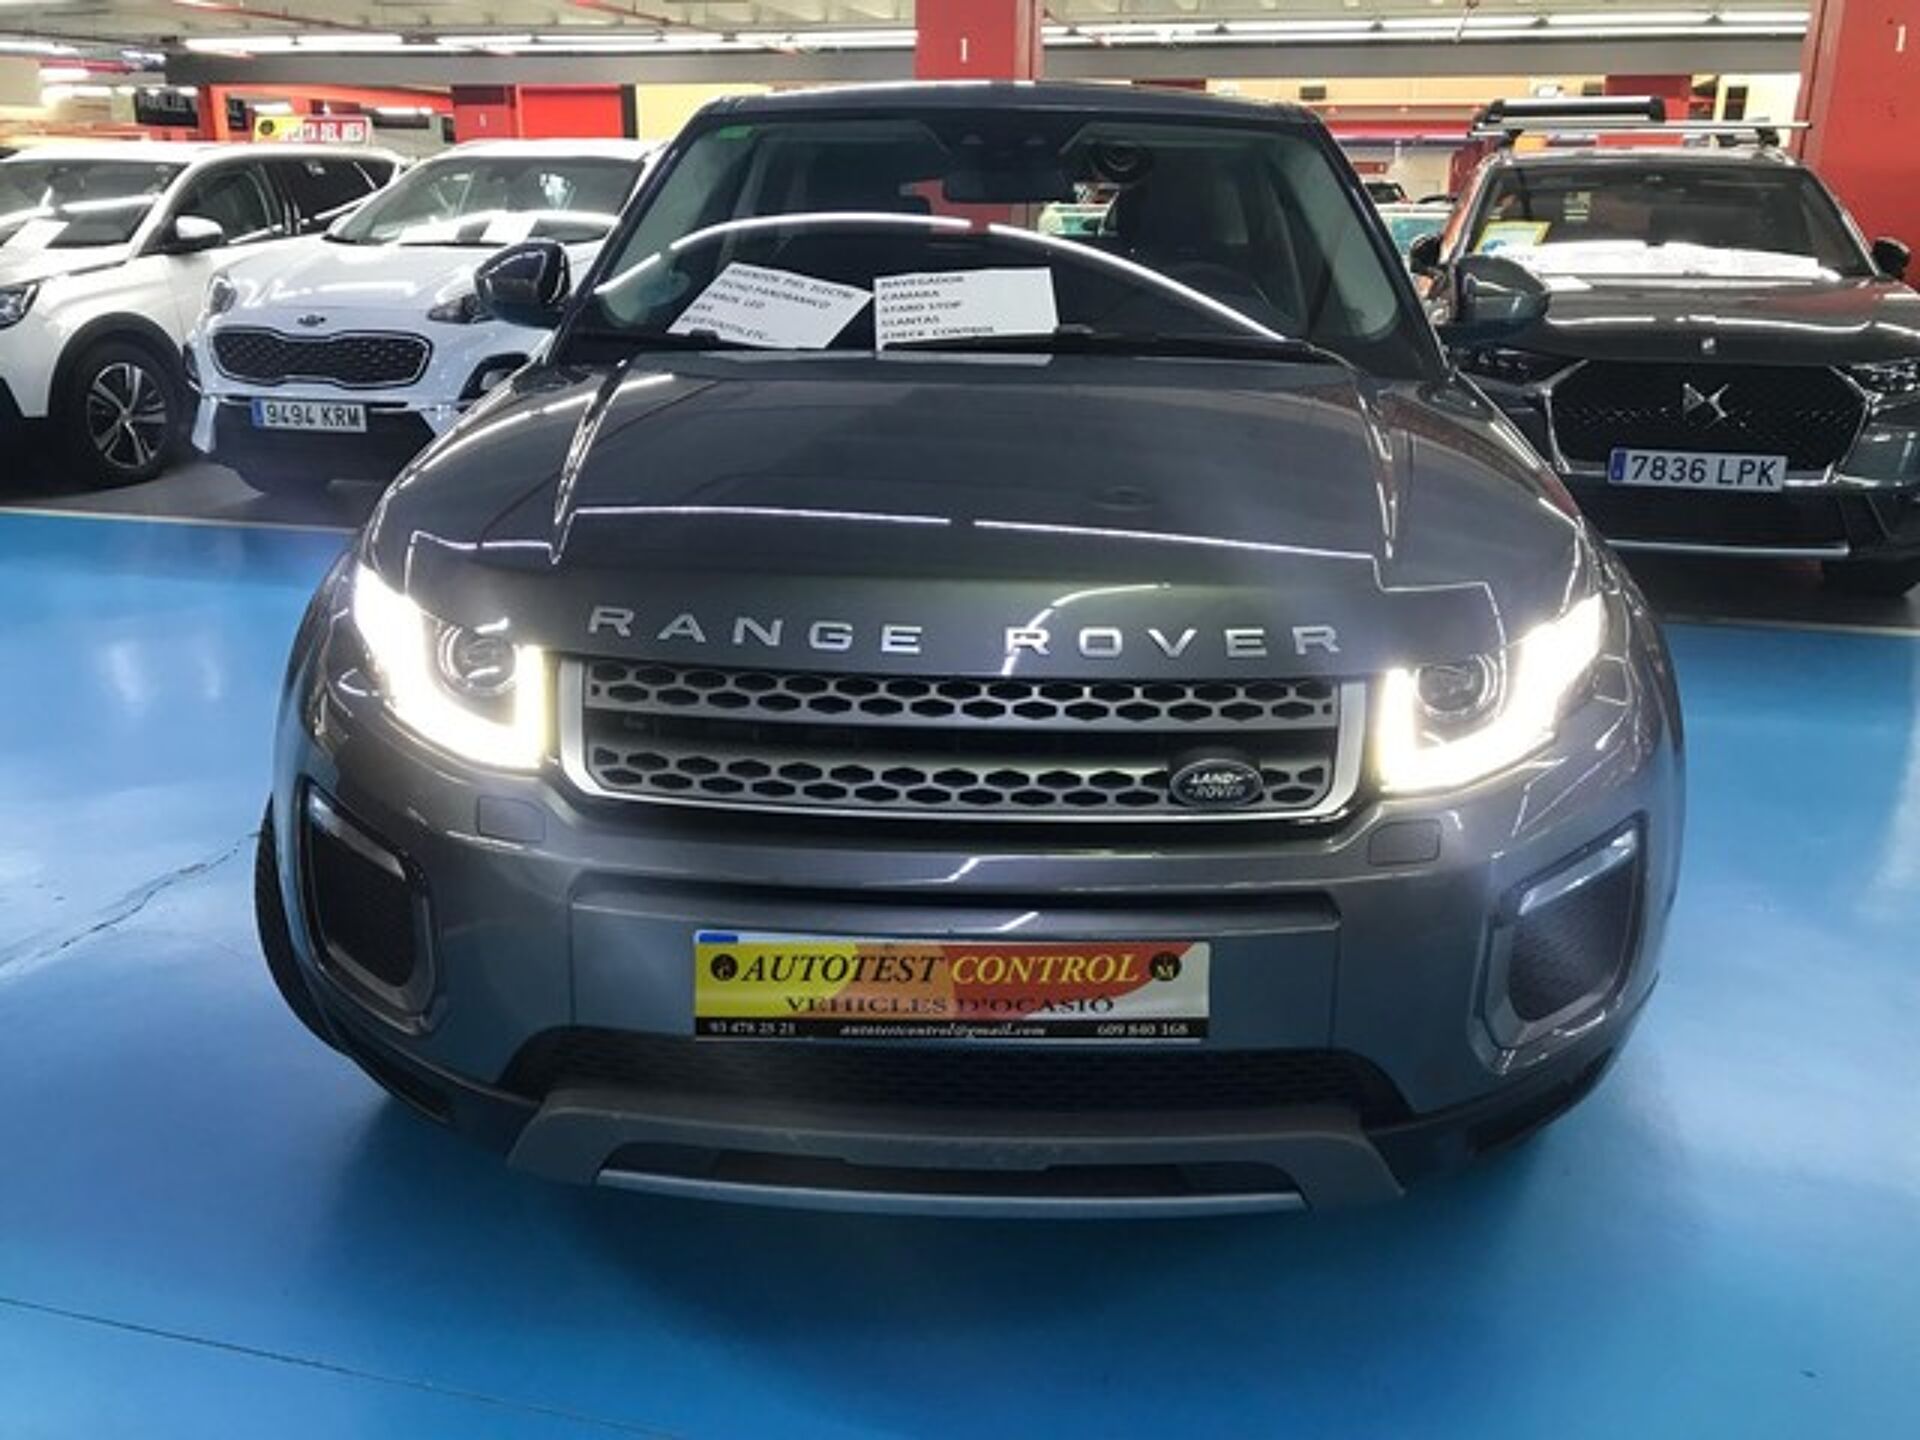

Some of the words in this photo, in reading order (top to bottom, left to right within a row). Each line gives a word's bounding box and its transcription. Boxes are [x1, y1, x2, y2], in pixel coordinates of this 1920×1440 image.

[266, 403, 316, 425] 9494
[321, 406, 360, 427] KRM
[1631, 455, 1707, 483] 7836
[1717, 459, 1777, 486] LPK
[588, 605, 923, 654] RANGE
[1004, 625, 1341, 658] ROVER
[741, 954, 945, 983] AUTOTEST
[952, 953, 1142, 985] CONTROL
[785, 997, 947, 1014] VEHICLES
